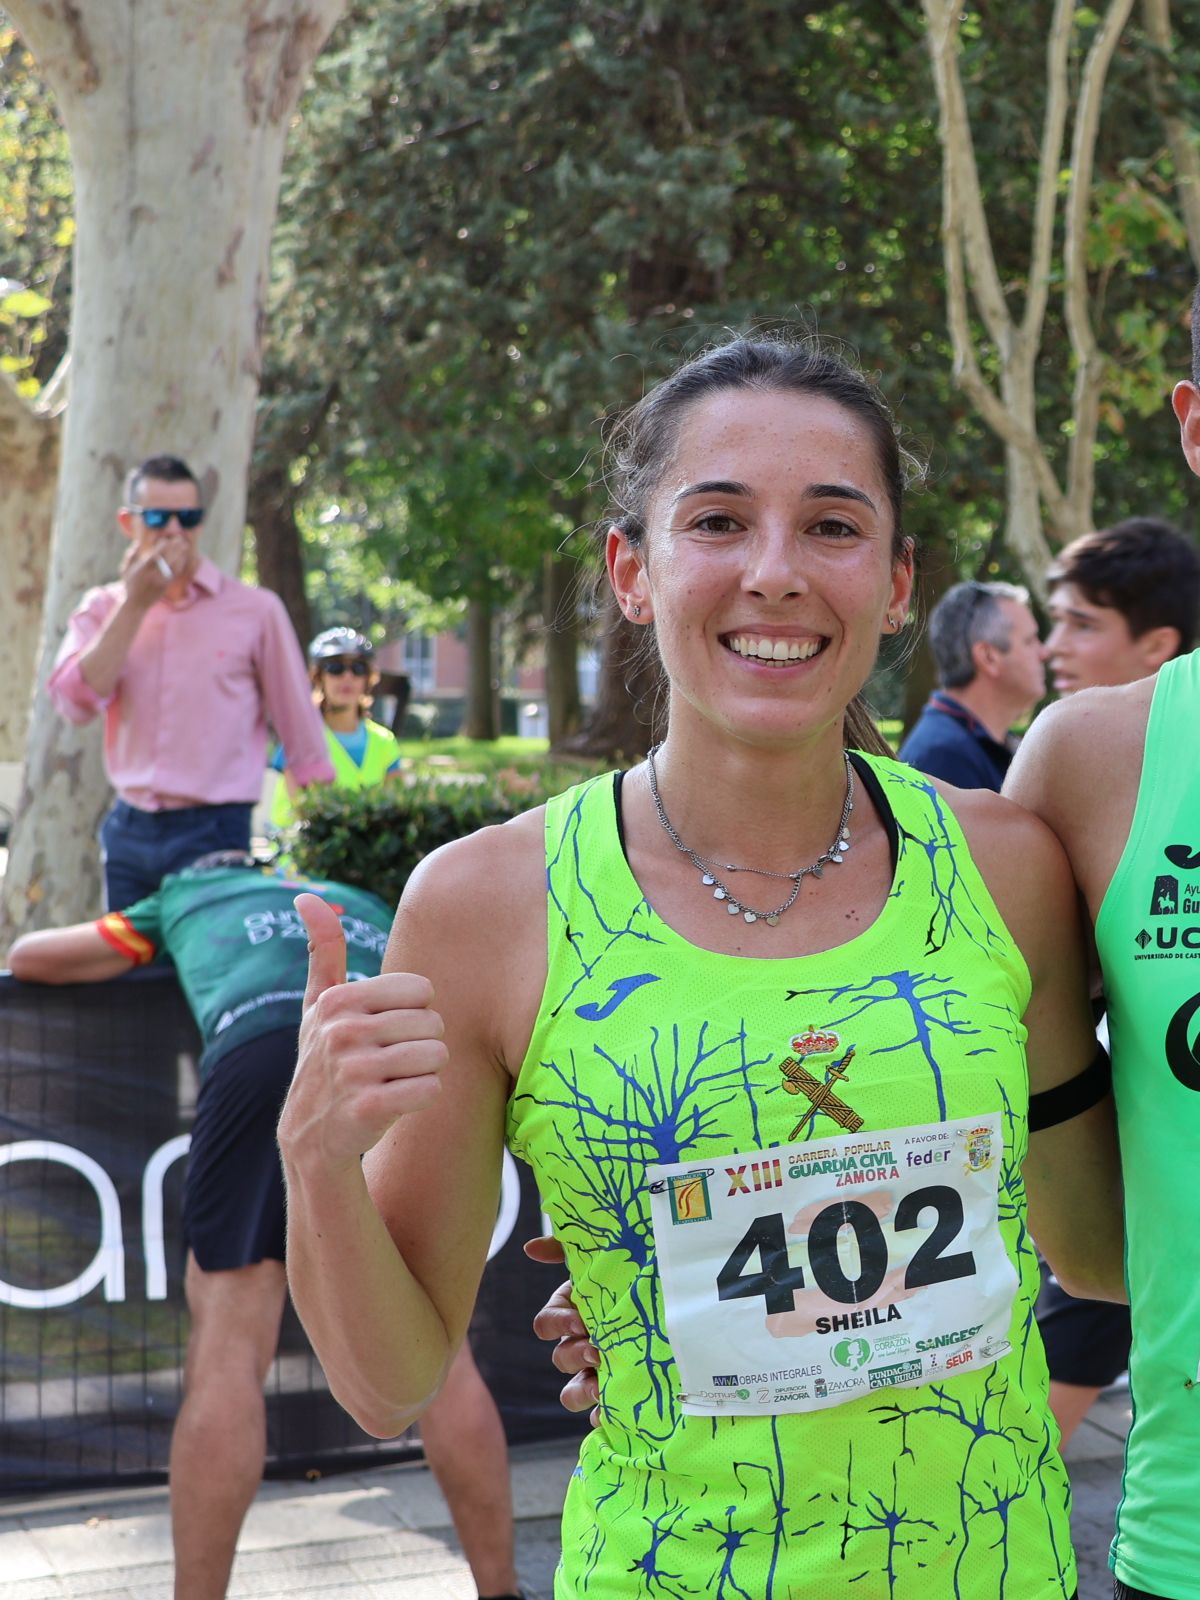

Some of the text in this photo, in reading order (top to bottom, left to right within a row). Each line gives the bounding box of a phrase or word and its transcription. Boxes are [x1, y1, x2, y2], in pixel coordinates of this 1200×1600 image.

[912, 1135, 936, 1144] FAVOR
[937, 1133, 950, 1141] DE:
[788, 1141, 891, 1164] CARRERA POPULAR
[906, 1149, 951, 1168] feder
[788, 1151, 897, 1179] GUARDIA CIVIL
[724, 1159, 783, 1197] XIII
[836, 1166, 899, 1187] ZAMORA
[716, 1185, 977, 1315] 402
[815, 1304, 902, 1335] SHEILA
[946, 1350, 973, 1370] SEUR
[713, 1365, 822, 1386] AVIVA OBRAS INTEGRALES
[827, 1378, 866, 1390] ZAMORA
[870, 1376, 893, 1388] CAJA
[894, 1370, 921, 1384] RURAL
[774, 1393, 810, 1403] ZAMORA
